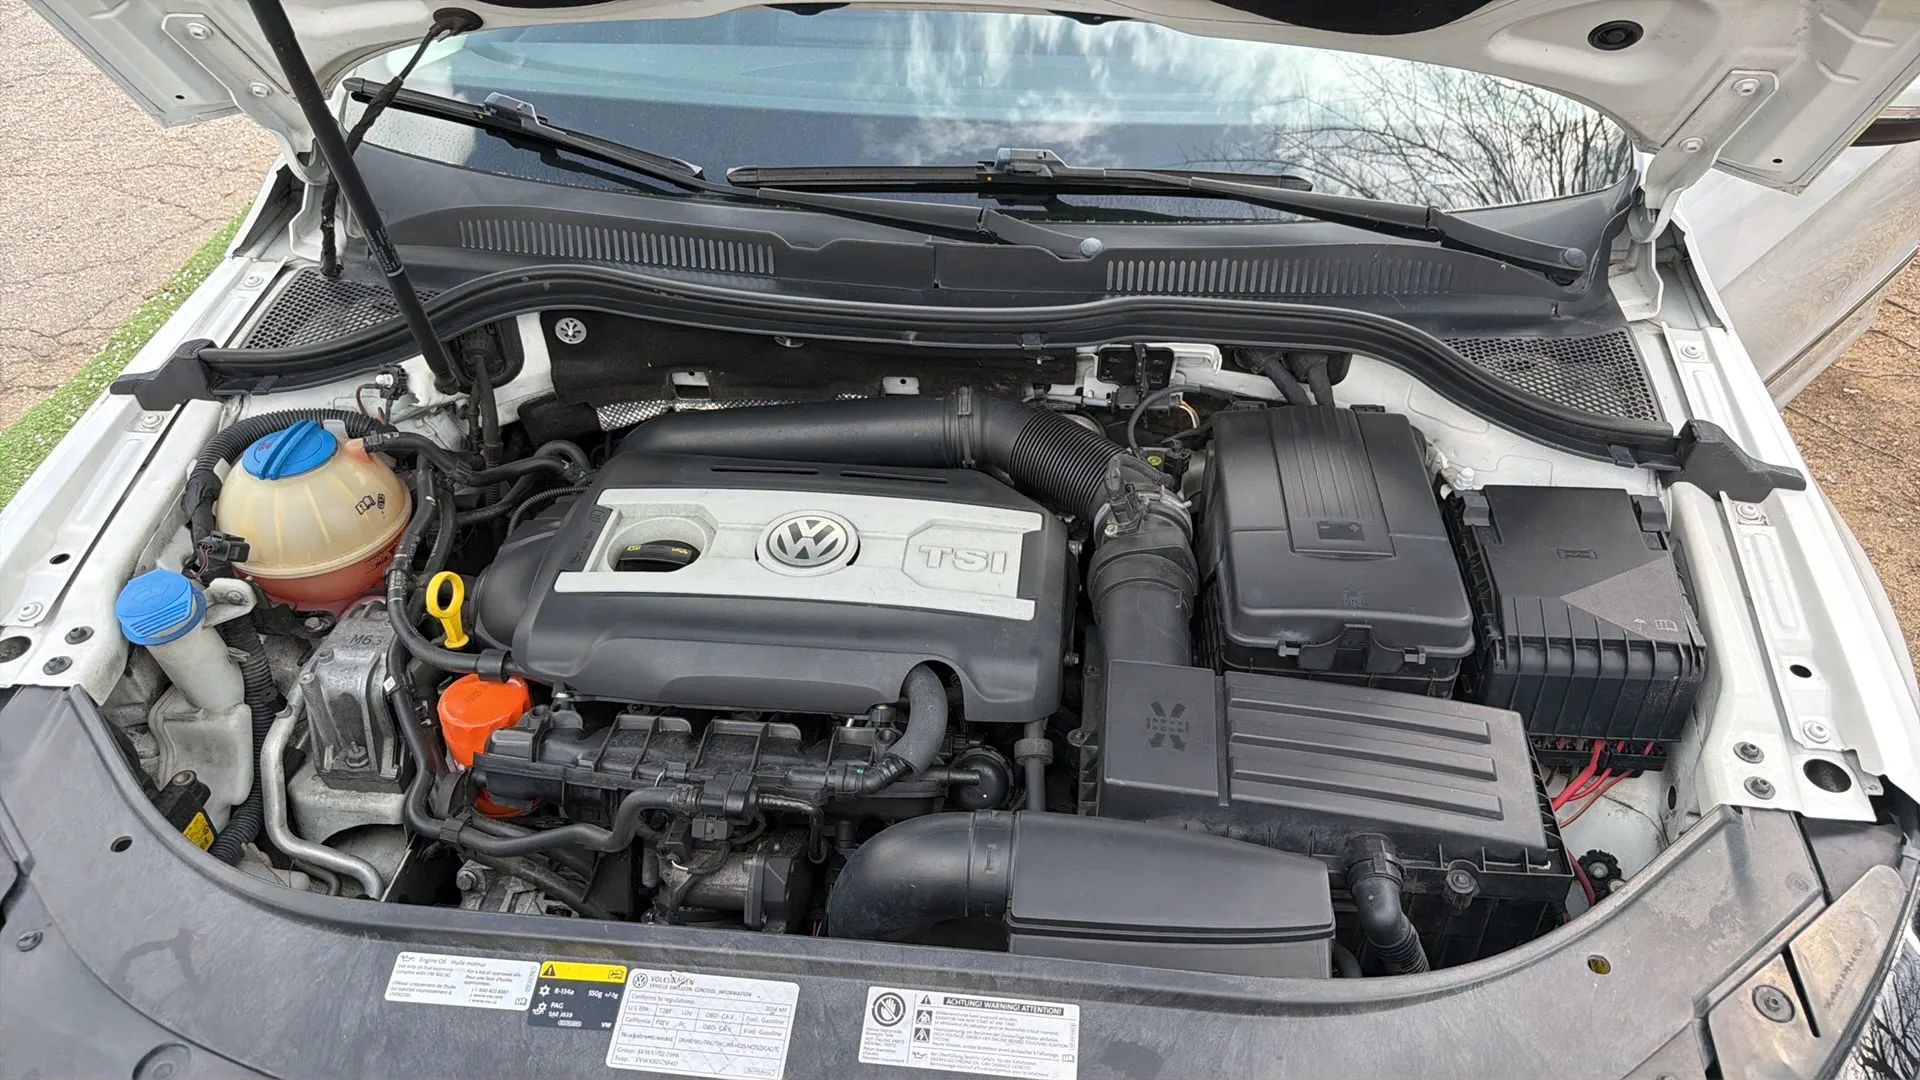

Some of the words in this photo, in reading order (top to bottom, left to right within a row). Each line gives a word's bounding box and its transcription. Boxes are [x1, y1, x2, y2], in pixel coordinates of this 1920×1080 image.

[919, 544, 1008, 575] TSI
[349, 634, 385, 646] M63
[419, 956, 438, 965] Engine
[438, 957, 448, 965] Oil
[451, 959, 466, 967] Huile
[650, 974, 695, 986] VOLKSWAGEN
[553, 987, 575, 996] R-134a
[718, 989, 753, 997] INFORMATION
[550, 1001, 565, 1009] PAG
[945, 998, 984, 1009] ACHTUNG!
[983, 1001, 1021, 1011] WARNING!
[1021, 1004, 1063, 1015] ATTENTION!
[601, 1021, 613, 1029] VW
[624, 1016, 651, 1025] California
